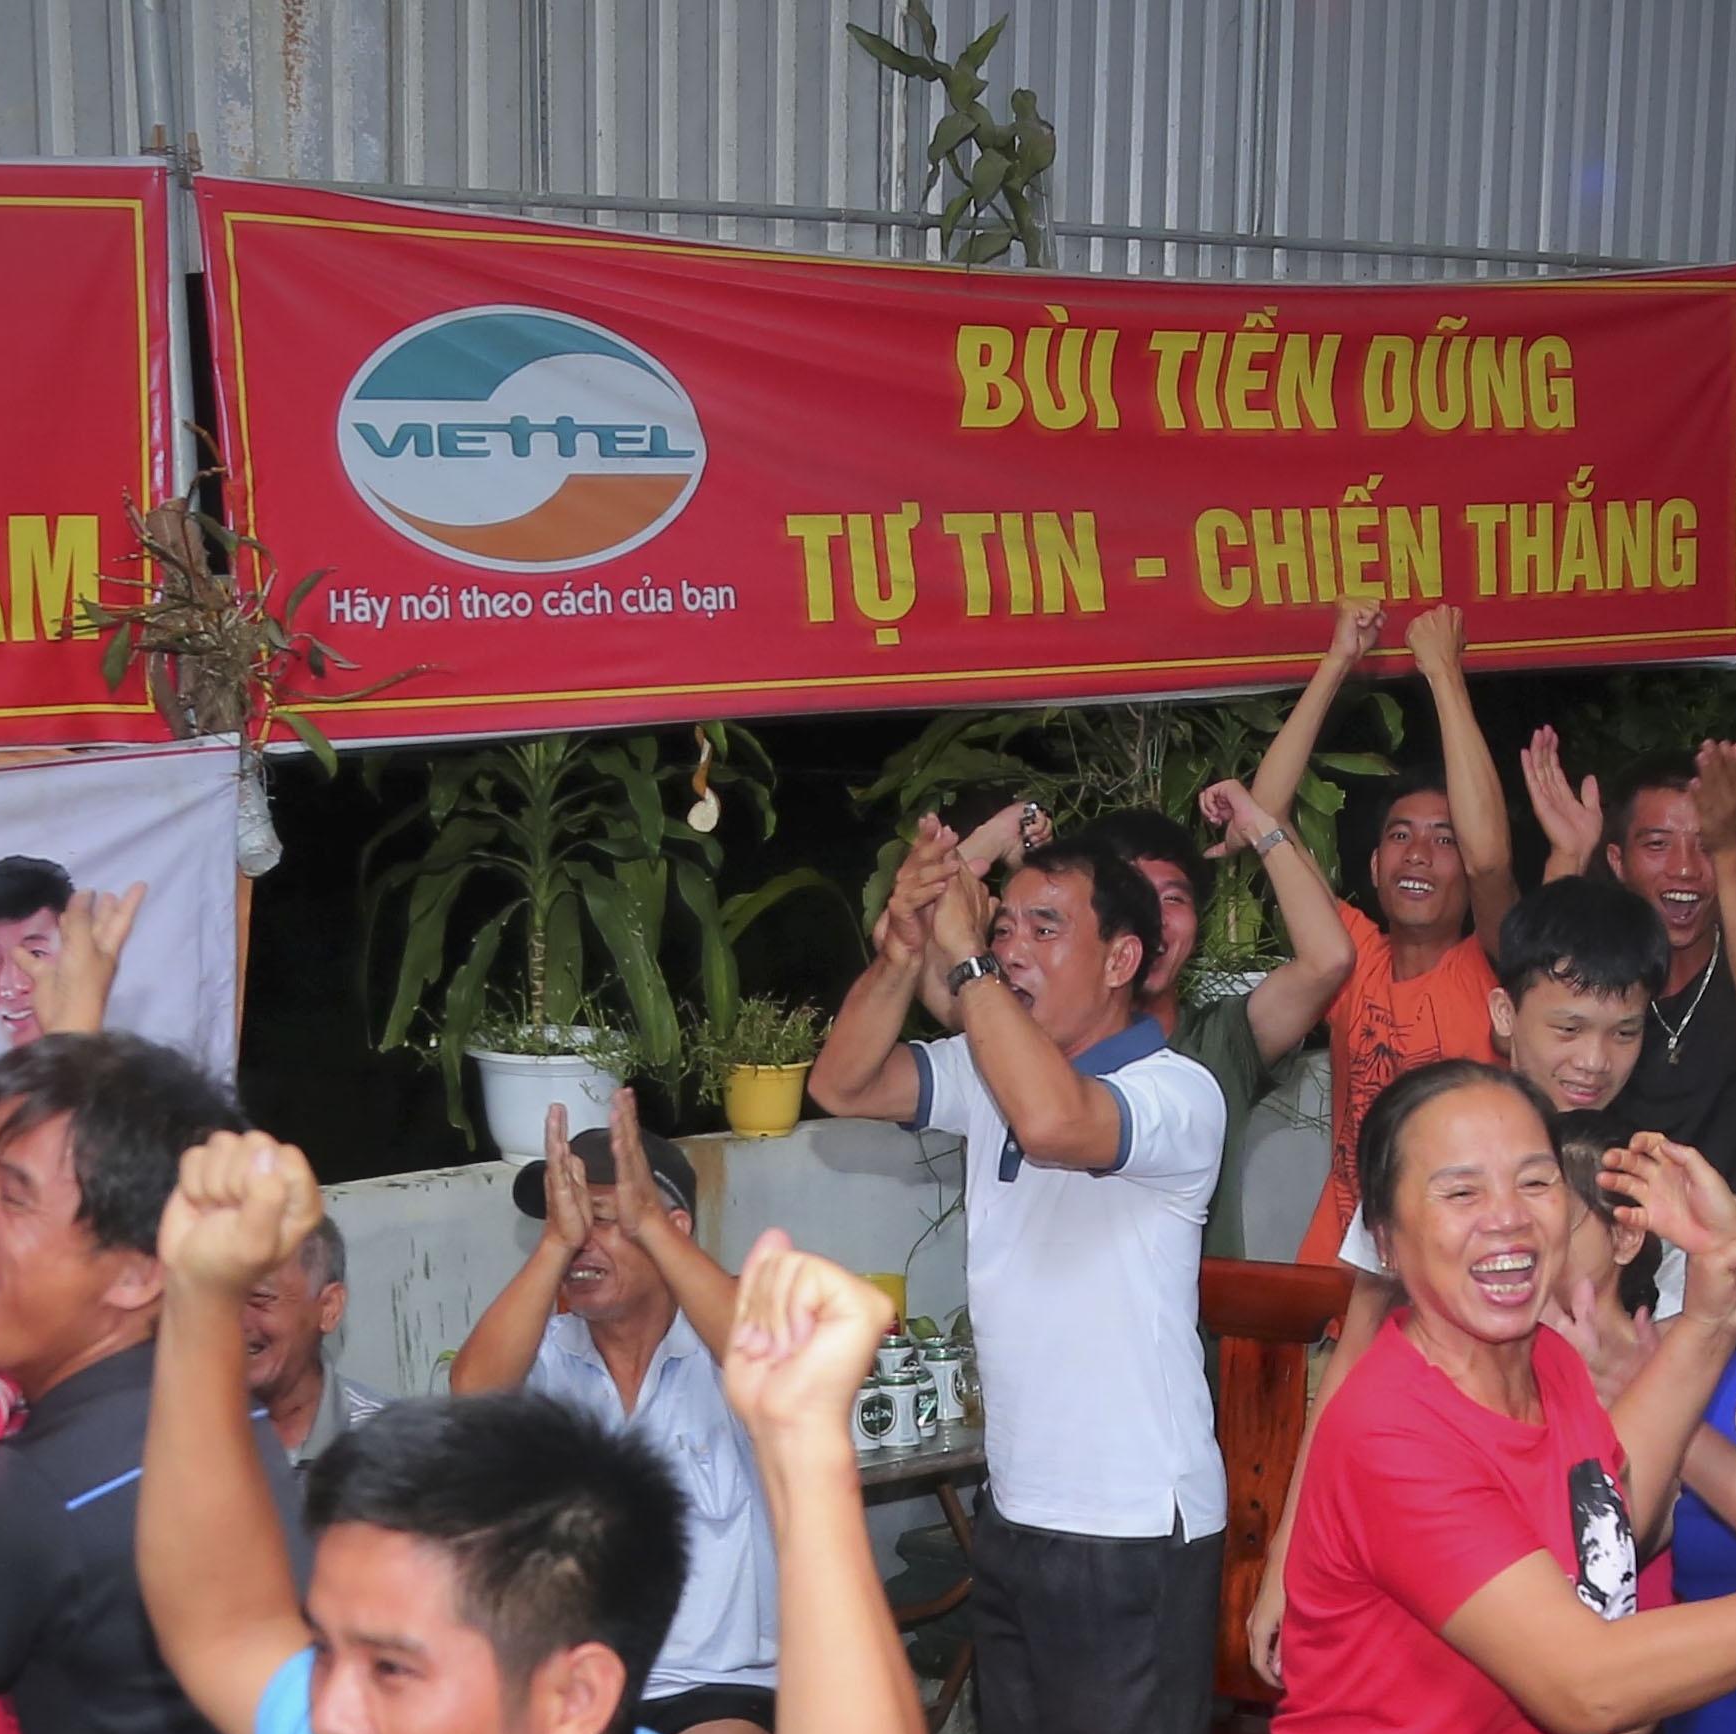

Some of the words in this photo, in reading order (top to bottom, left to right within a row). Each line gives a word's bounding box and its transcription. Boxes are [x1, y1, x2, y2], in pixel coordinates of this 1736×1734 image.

[956, 304, 1121, 430] BÙI
[1363, 315, 1576, 430] DŨNG
[328, 587, 390, 630] Hãy
[400, 585, 452, 621] nói
[460, 585, 533, 618] theo
[541, 581, 613, 617] cách
[620, 575, 673, 614] của
[681, 579, 737, 619] bạn
[786, 500, 922, 645] TỰ
[943, 510, 1106, 616] TIN
[1194, 474, 1443, 607] CHIẾN
[1466, 465, 1698, 596] THẮNG
